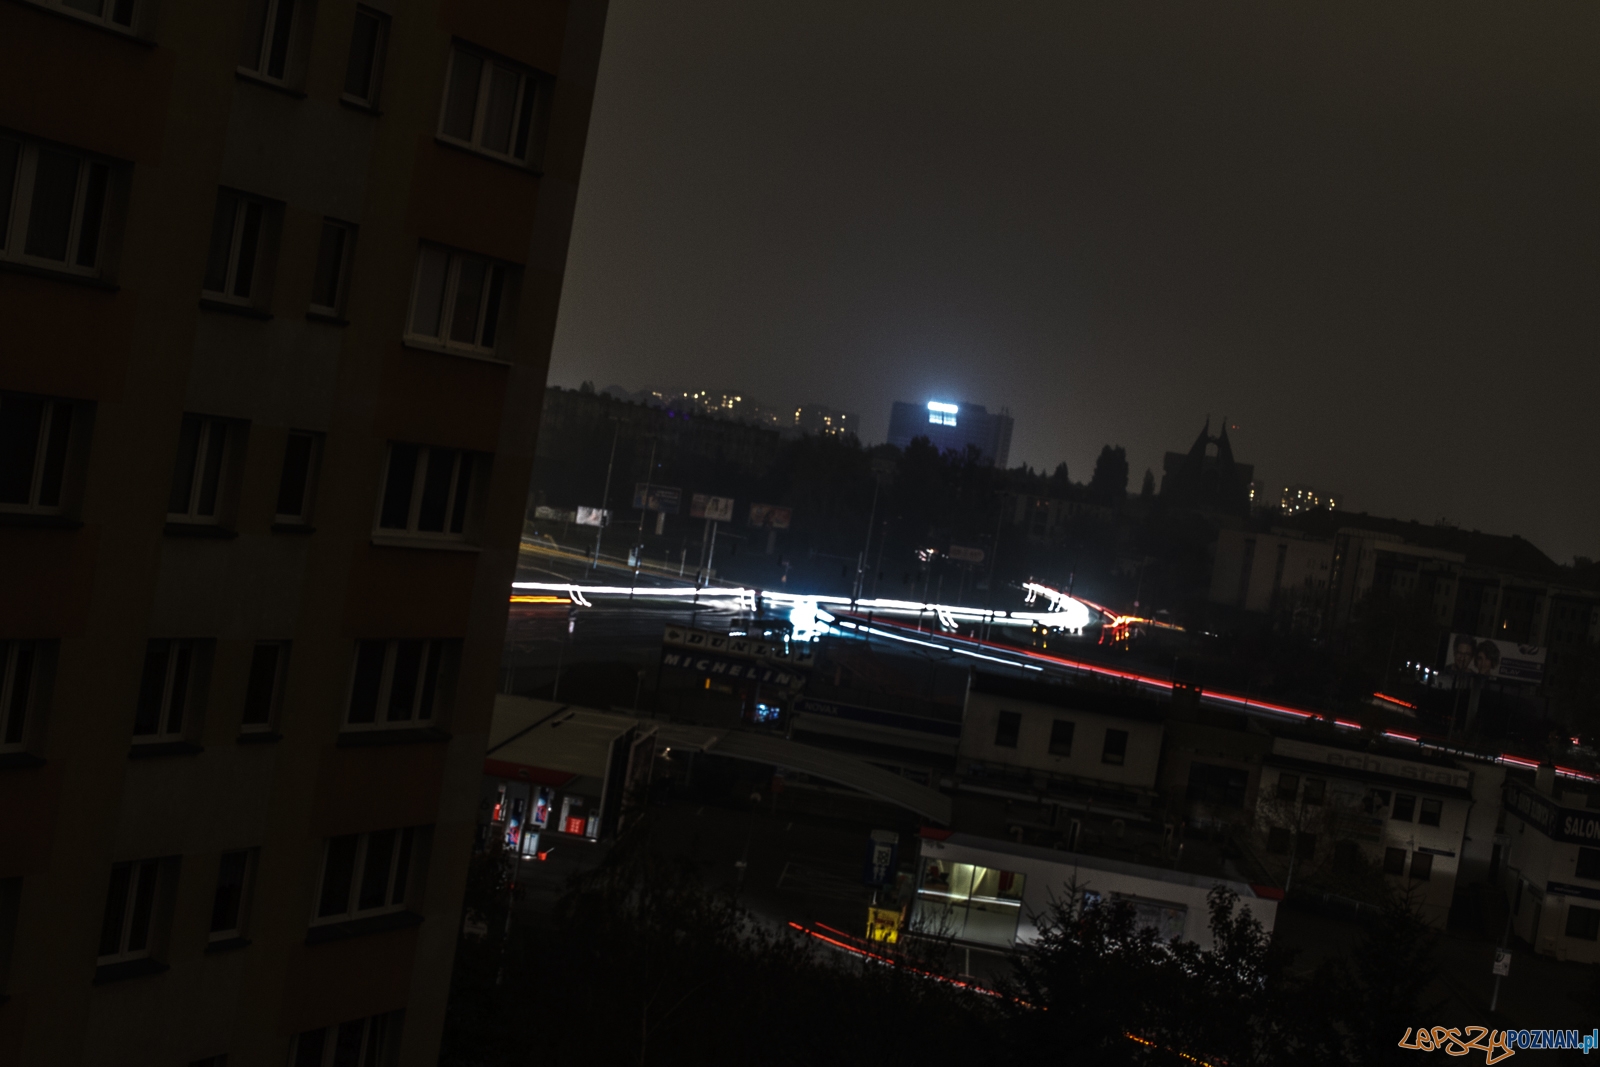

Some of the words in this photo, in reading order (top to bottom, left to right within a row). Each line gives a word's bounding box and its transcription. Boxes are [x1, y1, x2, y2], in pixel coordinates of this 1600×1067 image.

[688, 633, 812, 662] DUNLOP
[664, 653, 796, 686] MICHELIN
[1326, 752, 1468, 786] echostar
[1563, 815, 1600, 839] SALON
